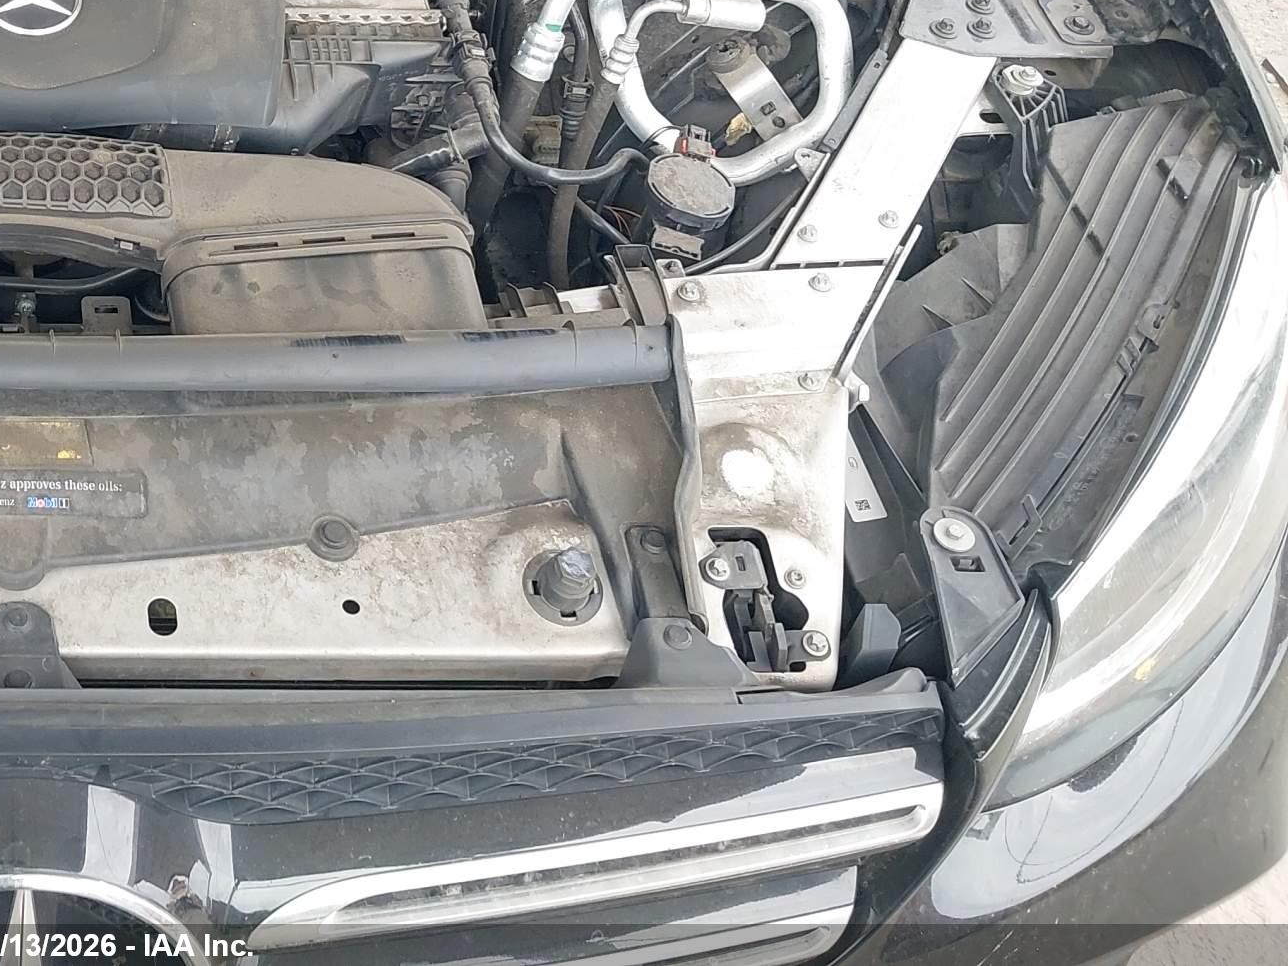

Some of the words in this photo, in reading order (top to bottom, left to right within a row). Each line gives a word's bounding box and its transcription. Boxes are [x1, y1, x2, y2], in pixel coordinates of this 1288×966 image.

[9, 480, 62, 492] approves
[64, 479, 95, 491] these
[98, 480, 123, 492] oils:
